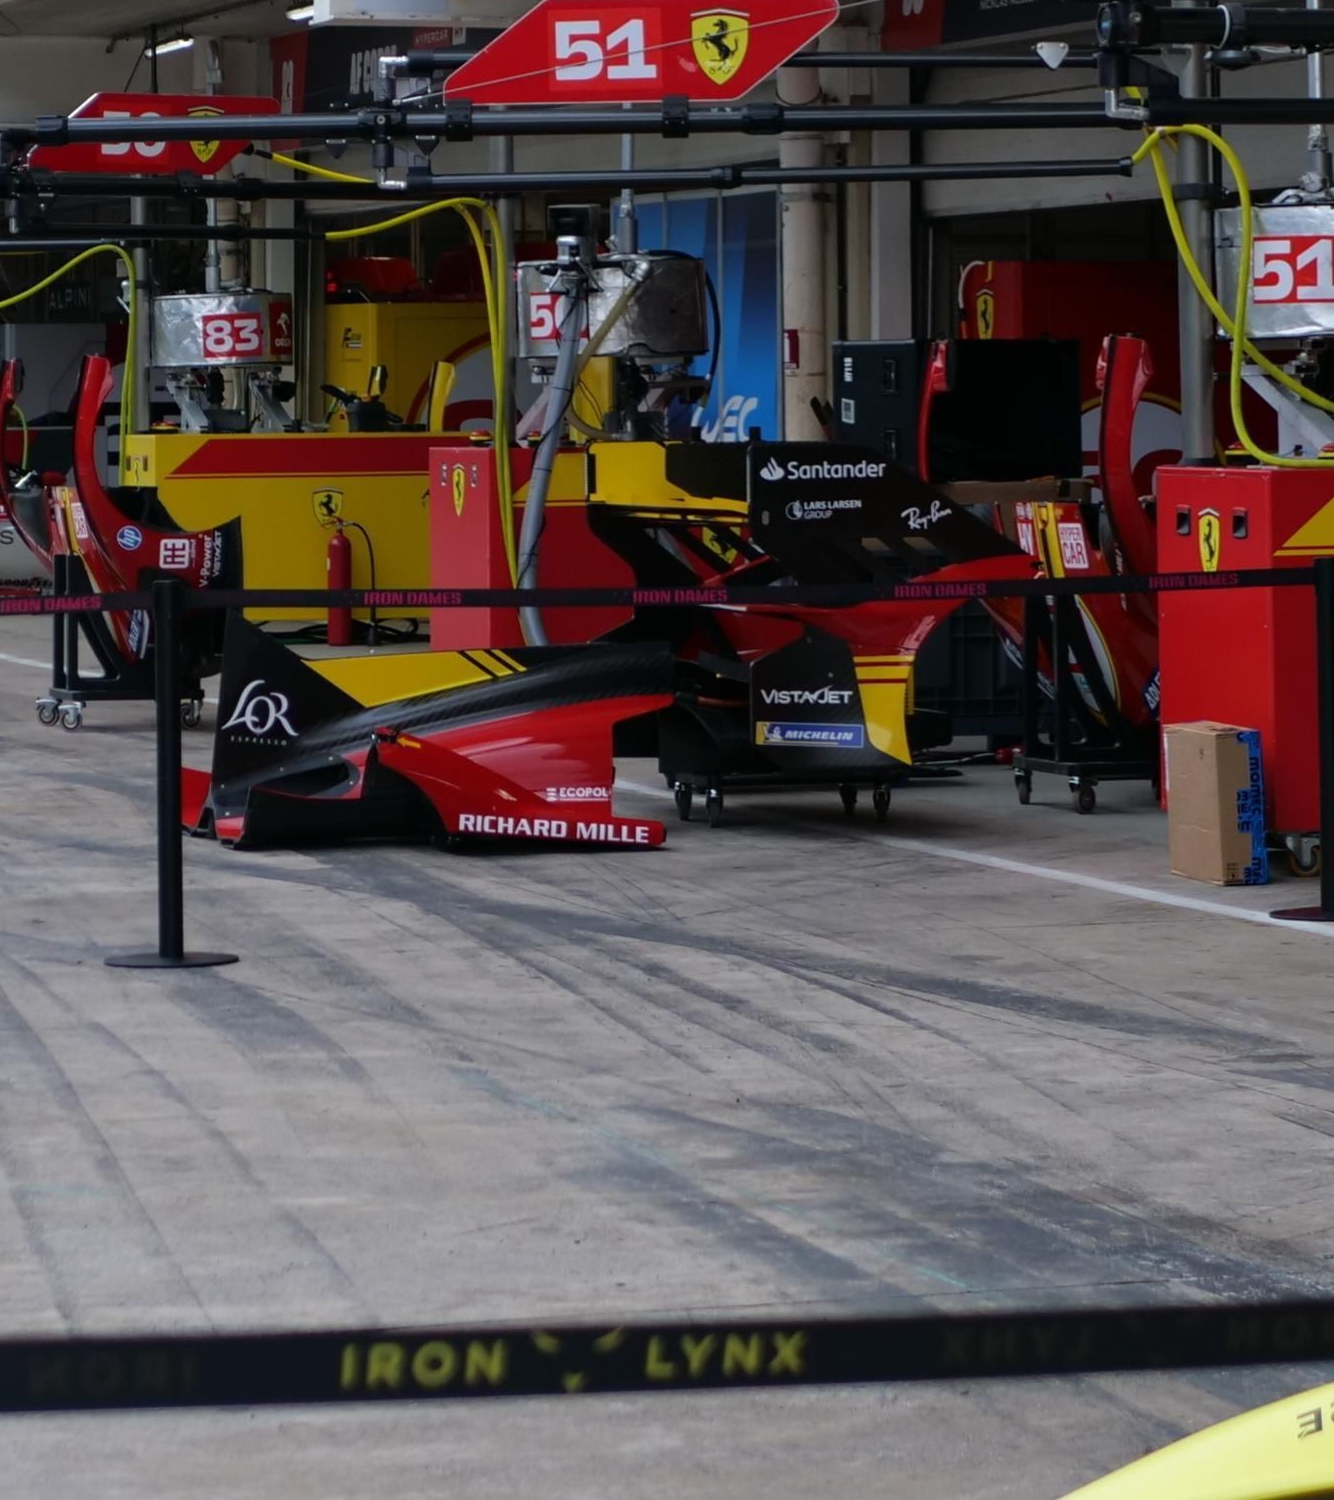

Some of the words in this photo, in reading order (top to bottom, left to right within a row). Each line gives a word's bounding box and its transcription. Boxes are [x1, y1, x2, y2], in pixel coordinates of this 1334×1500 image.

[554, 19, 657, 81] 51
[204, 318, 261, 354] 83
[786, 460, 887, 481] Santander
[804, 501, 827, 511] LARS
[828, 499, 863, 510] LARSEN
[803, 510, 833, 520] GROUP
[900, 500, 954, 532] Ray-Ban
[198, 534, 213, 589] V-Power
[1063, 541, 1087, 567] CAR
[894, 584, 932, 598] IRON
[934, 582, 988, 597] DAMES
[1149, 575, 1186, 590] IRON
[1187, 572, 1240, 587] DAMES
[0, 598, 42, 614] IRON
[44, 595, 102, 611] DAMES
[364, 591, 402, 605] IRON
[405, 590, 463, 605] DAMES
[632, 589, 671, 603] IRON
[675, 587, 728, 602] DAMES
[784, 729, 854, 741] MICHELIN
[559, 786, 609, 798] ECOPOL
[458, 813, 568, 838] RICHARD
[576, 822, 650, 844] MILLE
[339, 1338, 511, 1390] IRON
[642, 1329, 811, 1381] LYNX
